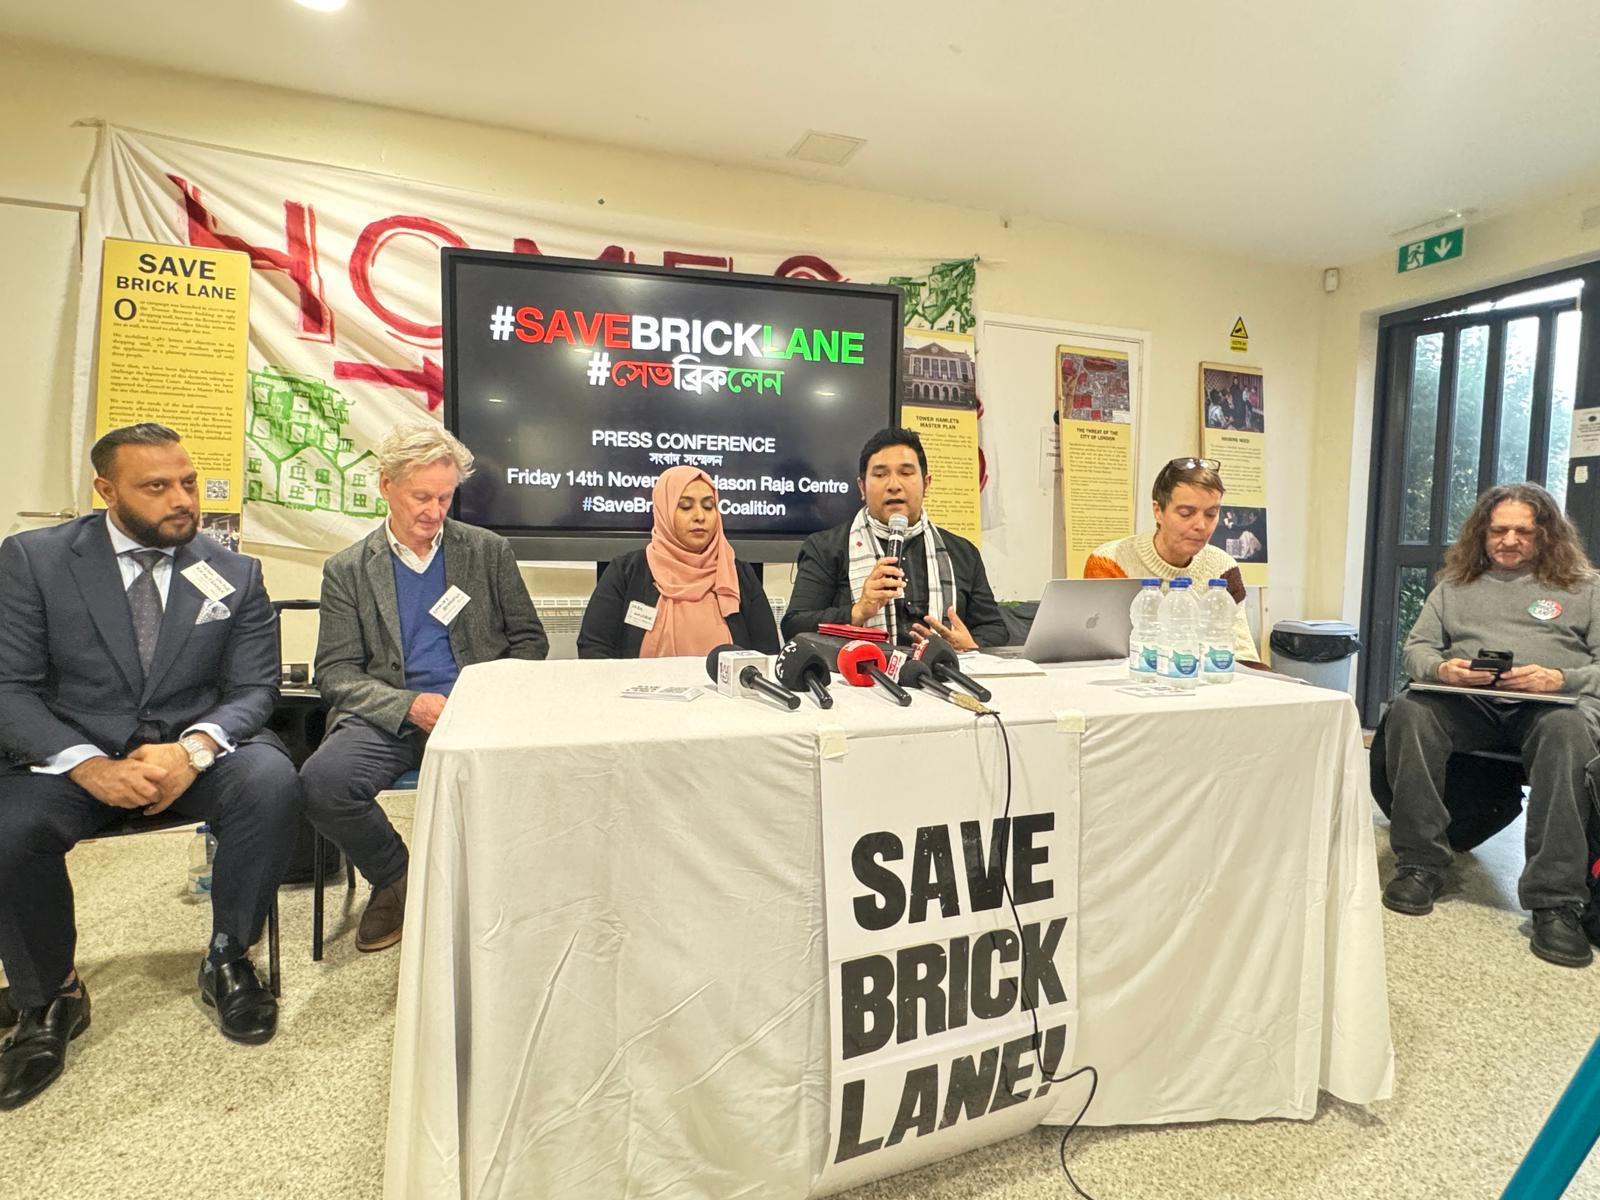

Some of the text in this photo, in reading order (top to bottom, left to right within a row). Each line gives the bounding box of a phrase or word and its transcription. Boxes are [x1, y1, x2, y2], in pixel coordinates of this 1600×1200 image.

[138, 253, 216, 281] SAVE
[116, 276, 237, 300] BRICK LANE
[490, 305, 865, 364] #SAVEBRICKLANE
[592, 430, 776, 453] PRESS CONFERENCE
[507, 468, 562, 489] Friday
[566, 470, 604, 486] 14th
[608, 472, 659, 488] Nove
[760, 476, 795, 495] Raja
[798, 477, 849, 493] Centre
[717, 499, 786, 516] Coalition
[850, 812, 1055, 931] SAVE
[840, 917, 1068, 1060] BRICK
[833, 1024, 1067, 1164] LANE!
